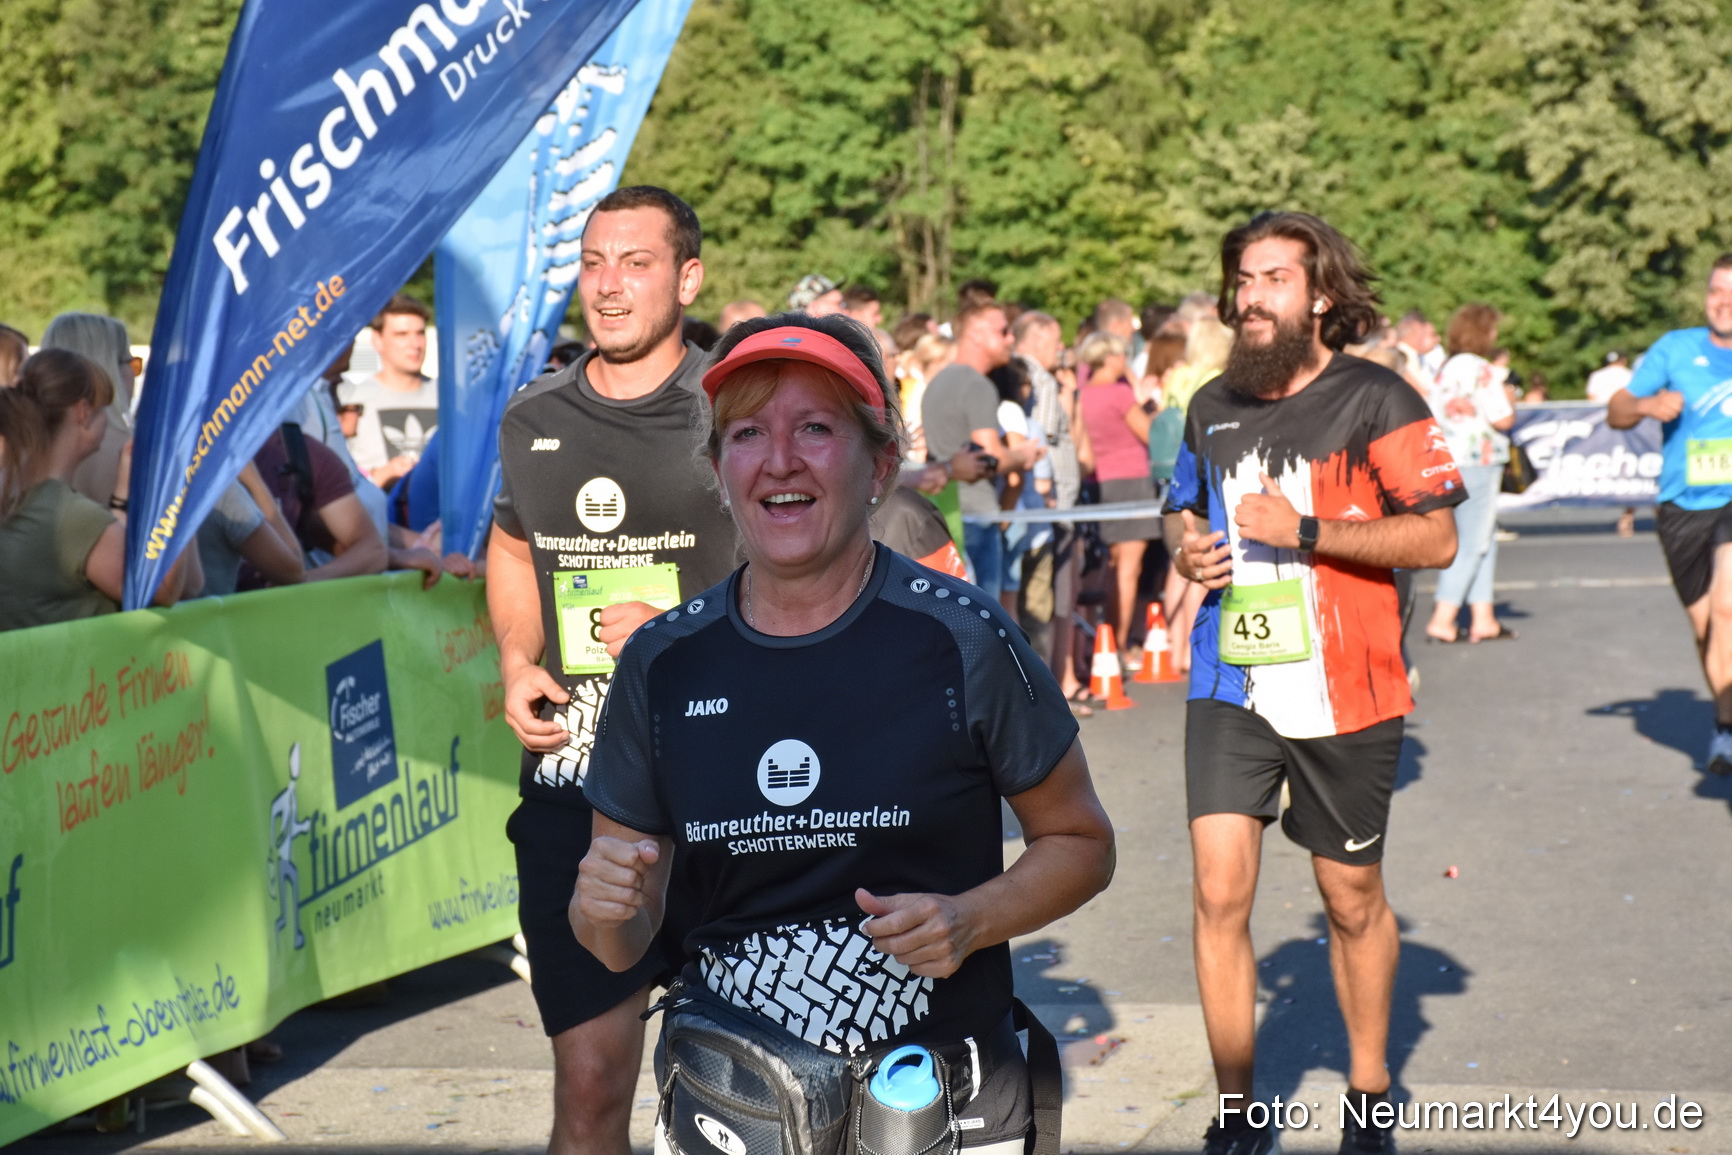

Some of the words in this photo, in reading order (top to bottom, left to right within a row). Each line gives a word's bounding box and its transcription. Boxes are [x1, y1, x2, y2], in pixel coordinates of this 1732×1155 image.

[438, 0, 532, 102] Druck
[531, 438, 561, 452] JAKO
[557, 553, 655, 569] SCHOTTERWERKE
[1234, 613, 1271, 641] 43
[2, 666, 111, 775] Gesunde
[117, 650, 194, 720] Firmen
[339, 691, 381, 731] Fischer
[685, 697, 729, 717] JAKO
[56, 748, 132, 835] laufen
[136, 692, 215, 796] länger!
[309, 736, 460, 897] firmenlauf
[685, 805, 911, 843] Bärnreuther+Deuerlein
[727, 832, 858, 856] SCHOTTERWERKE
[314, 867, 385, 934] neumarkt
